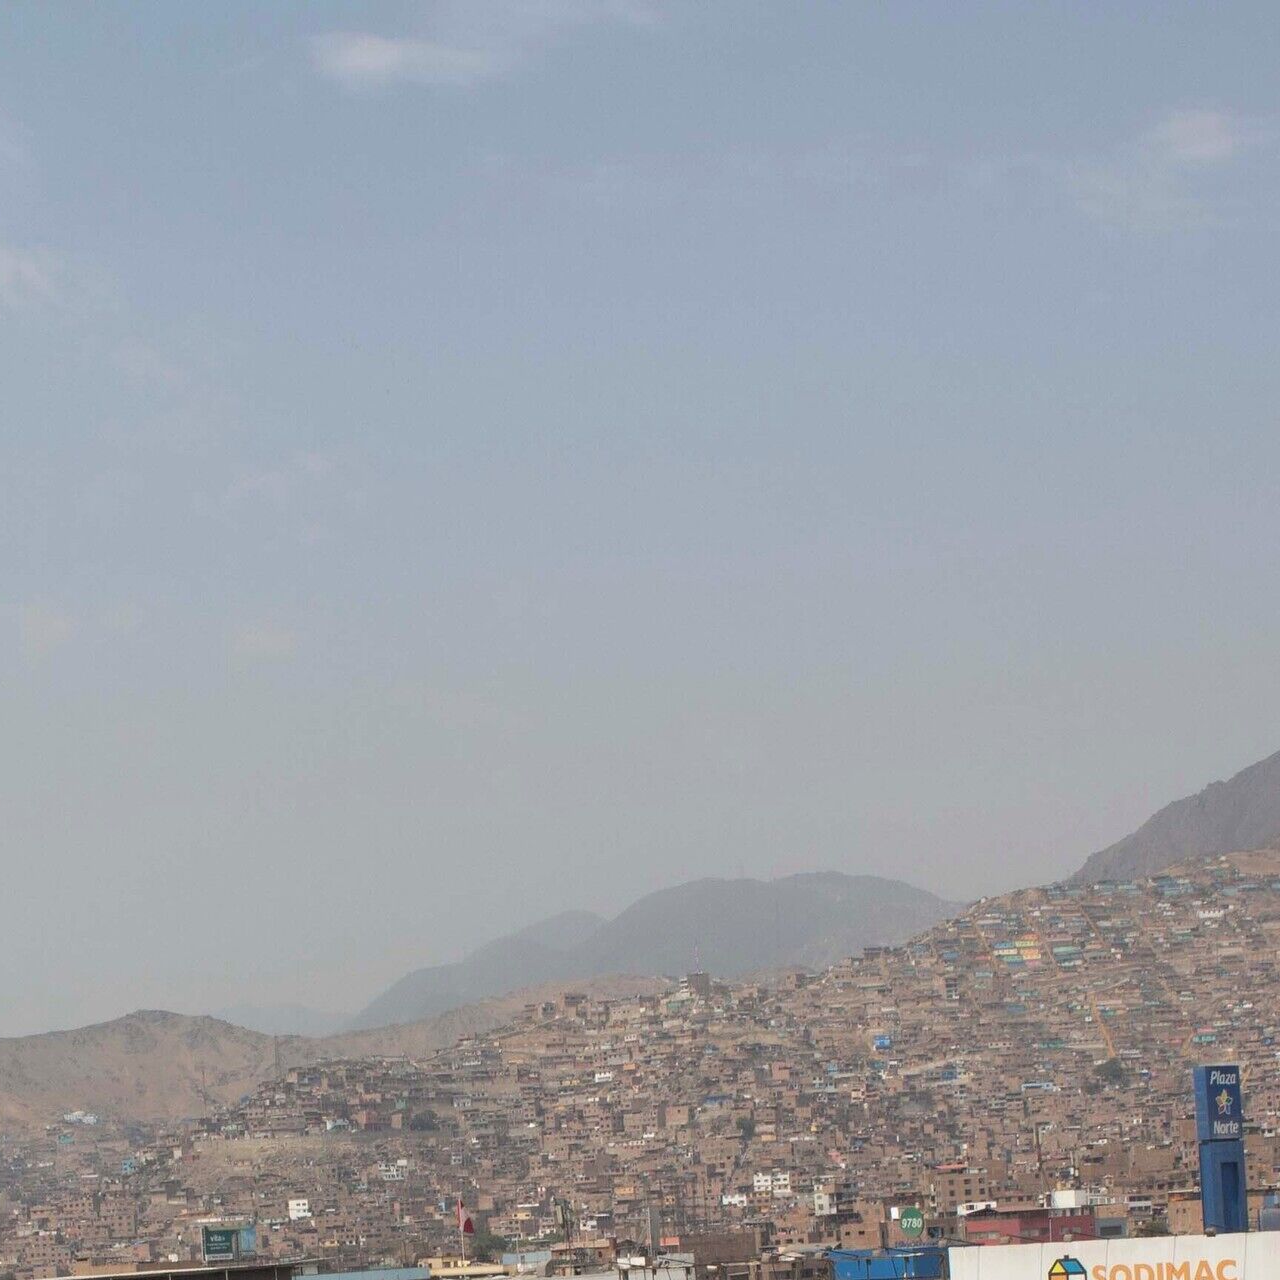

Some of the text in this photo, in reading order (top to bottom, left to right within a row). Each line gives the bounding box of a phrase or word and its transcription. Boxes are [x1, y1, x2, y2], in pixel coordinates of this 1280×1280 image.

[1210, 1070, 1236, 1085] Plaza
[1213, 1120, 1239, 1134] Norte
[901, 1217, 923, 1229] 9780
